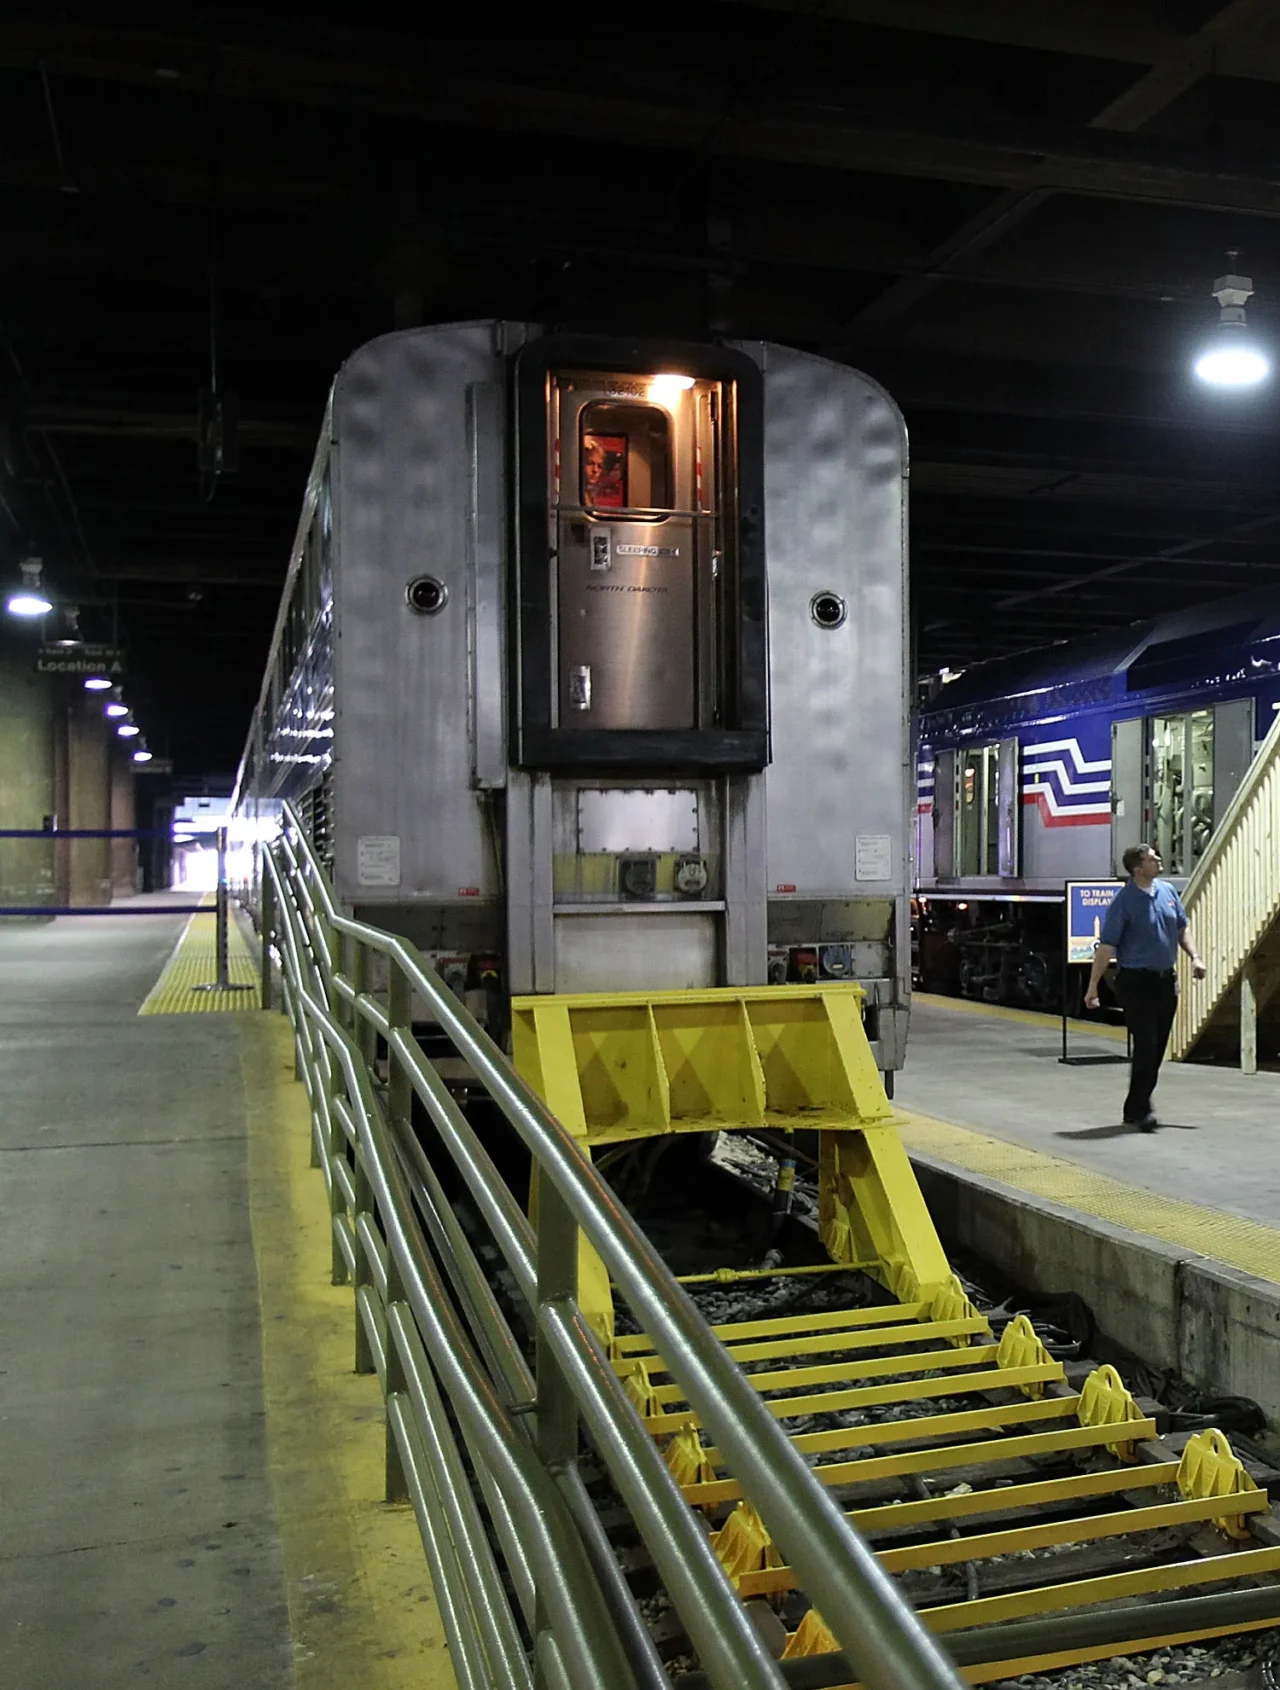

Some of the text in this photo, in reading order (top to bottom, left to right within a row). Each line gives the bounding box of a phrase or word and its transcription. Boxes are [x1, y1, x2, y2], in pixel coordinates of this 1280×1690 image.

[621, 546, 657, 555] SLEEPING
[627, 585, 667, 593] DAKOTA
[38, 660, 122, 671] Location A
[1092, 890, 1114, 898] TRAIN
[1082, 898, 1111, 906] DISPLAY
